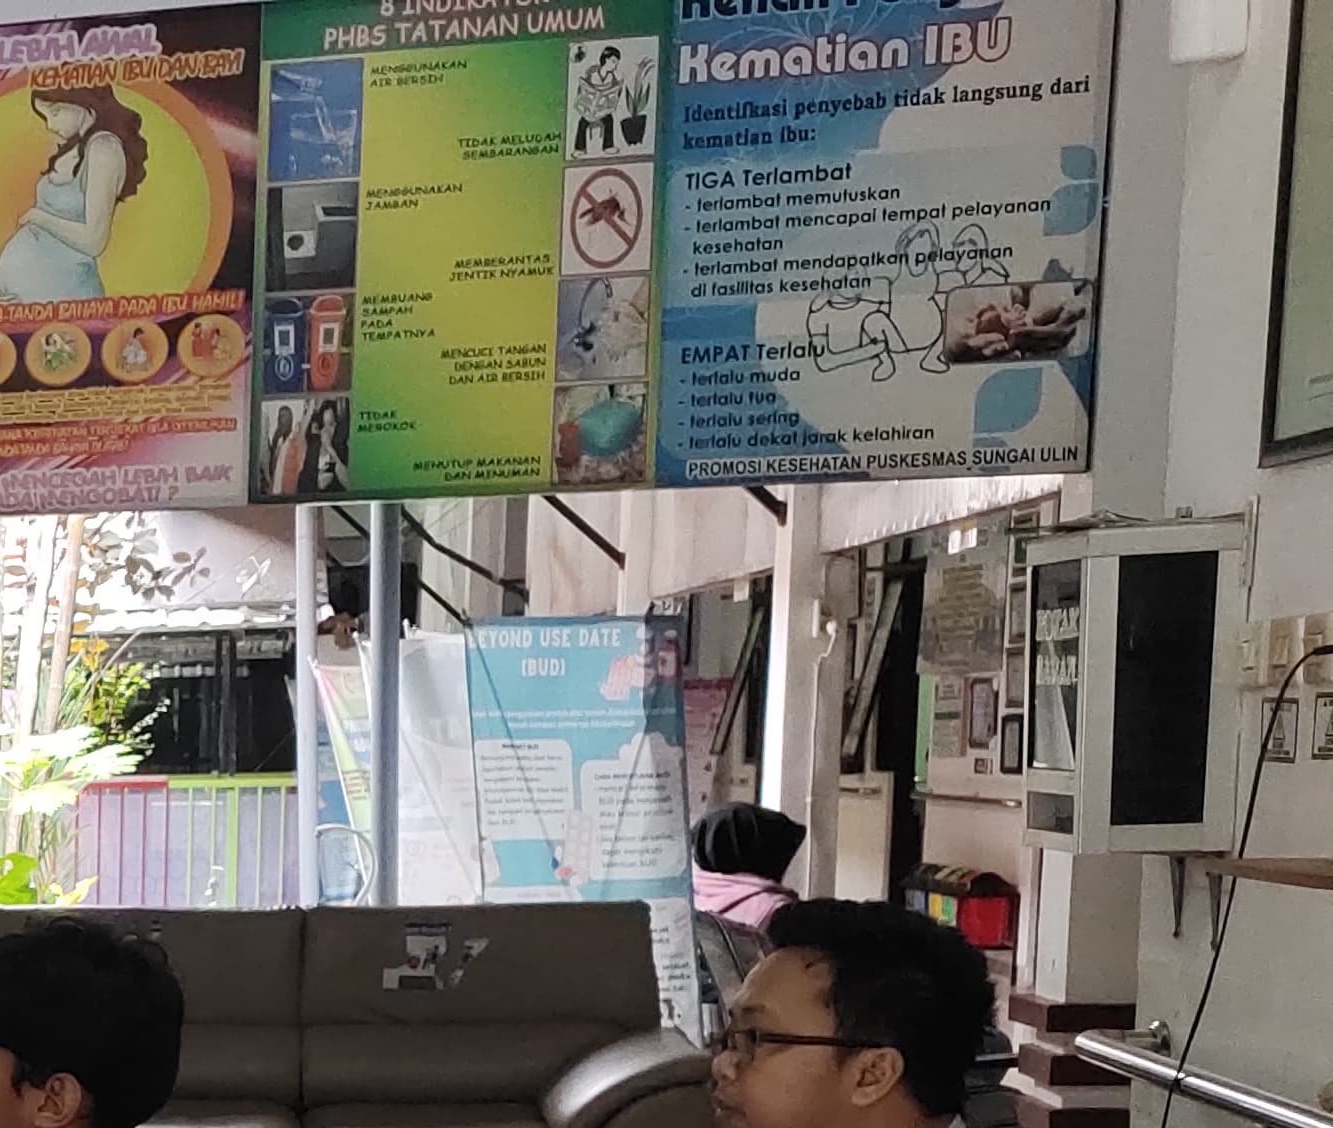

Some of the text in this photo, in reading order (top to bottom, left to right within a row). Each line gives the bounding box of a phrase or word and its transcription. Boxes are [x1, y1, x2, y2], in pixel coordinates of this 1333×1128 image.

[323, 25, 386, 50] PHBS
[394, 13, 519, 44] TATANAN
[527, 6, 605, 33] UMUM
[83, 26, 162, 56] AWAL
[676, 16, 1012, 86] Kematian IBU
[30, 49, 244, 90] KEMATIAN IBU DAN BAYI
[370, 60, 468, 76] MENGGUNAKAN
[370, 73, 445, 88] AIR BERSIH
[794, 75, 1090, 120] penyebab tidak langsung dari
[457, 131, 562, 149] TIDAK MELUDAH
[682, 129, 773, 151] kematian
[462, 144, 559, 160] SEMBARANGAN
[685, 165, 852, 191] TIGA Terlambat
[366, 183, 463, 199] MENGGUNAKAN
[365, 199, 419, 211] JAMBAN
[697, 187, 901, 213] terlambat memutuskan
[696, 199, 1051, 233] terlambat mencapai tempat pelayanan
[692, 237, 783, 254] kesehatan
[454, 254, 551, 269] MEMBERANTAS
[694, 245, 1013, 278] terlambat mendapatkan pelayanan
[449, 266, 554, 282] JENTIK NYAMUK
[691, 275, 871, 298] di fasilitas kesehatan
[57, 299, 113, 319] BAHAYA
[118, 296, 156, 314] PADA
[161, 293, 188, 312] IBU
[362, 292, 432, 305] MEMBUANG
[361, 306, 413, 317] SAMPAH
[360, 319, 393, 329] PADA
[361, 328, 435, 342] TEMPATNYA
[440, 343, 547, 360] MENCUCI TANGAN
[681, 342, 827, 365] EMPAT Terlalu
[454, 357, 546, 372] DENGAN SABUN
[449, 371, 545, 386] DAN AIR BERSIH
[692, 368, 801, 385] terlalu muda
[691, 390, 776, 406] terlalu tua
[359, 410, 397, 421] TIDAK
[690, 412, 800, 428] terlalu sering
[357, 421, 416, 433] MEROKOK
[689, 426, 933, 449] terlalu dekat jarak kelahiran
[413, 456, 541, 471] MENUTUP MAKANAN
[688, 446, 1078, 476] PROMOSI KESEHATAN PUSKESMAS SUNGAI ULIN
[444, 468, 540, 482] DAN MINUMAN
[540, 629, 571, 647] USE
[579, 628, 621, 647] DATE
[522, 659, 566, 677] (BUD)
